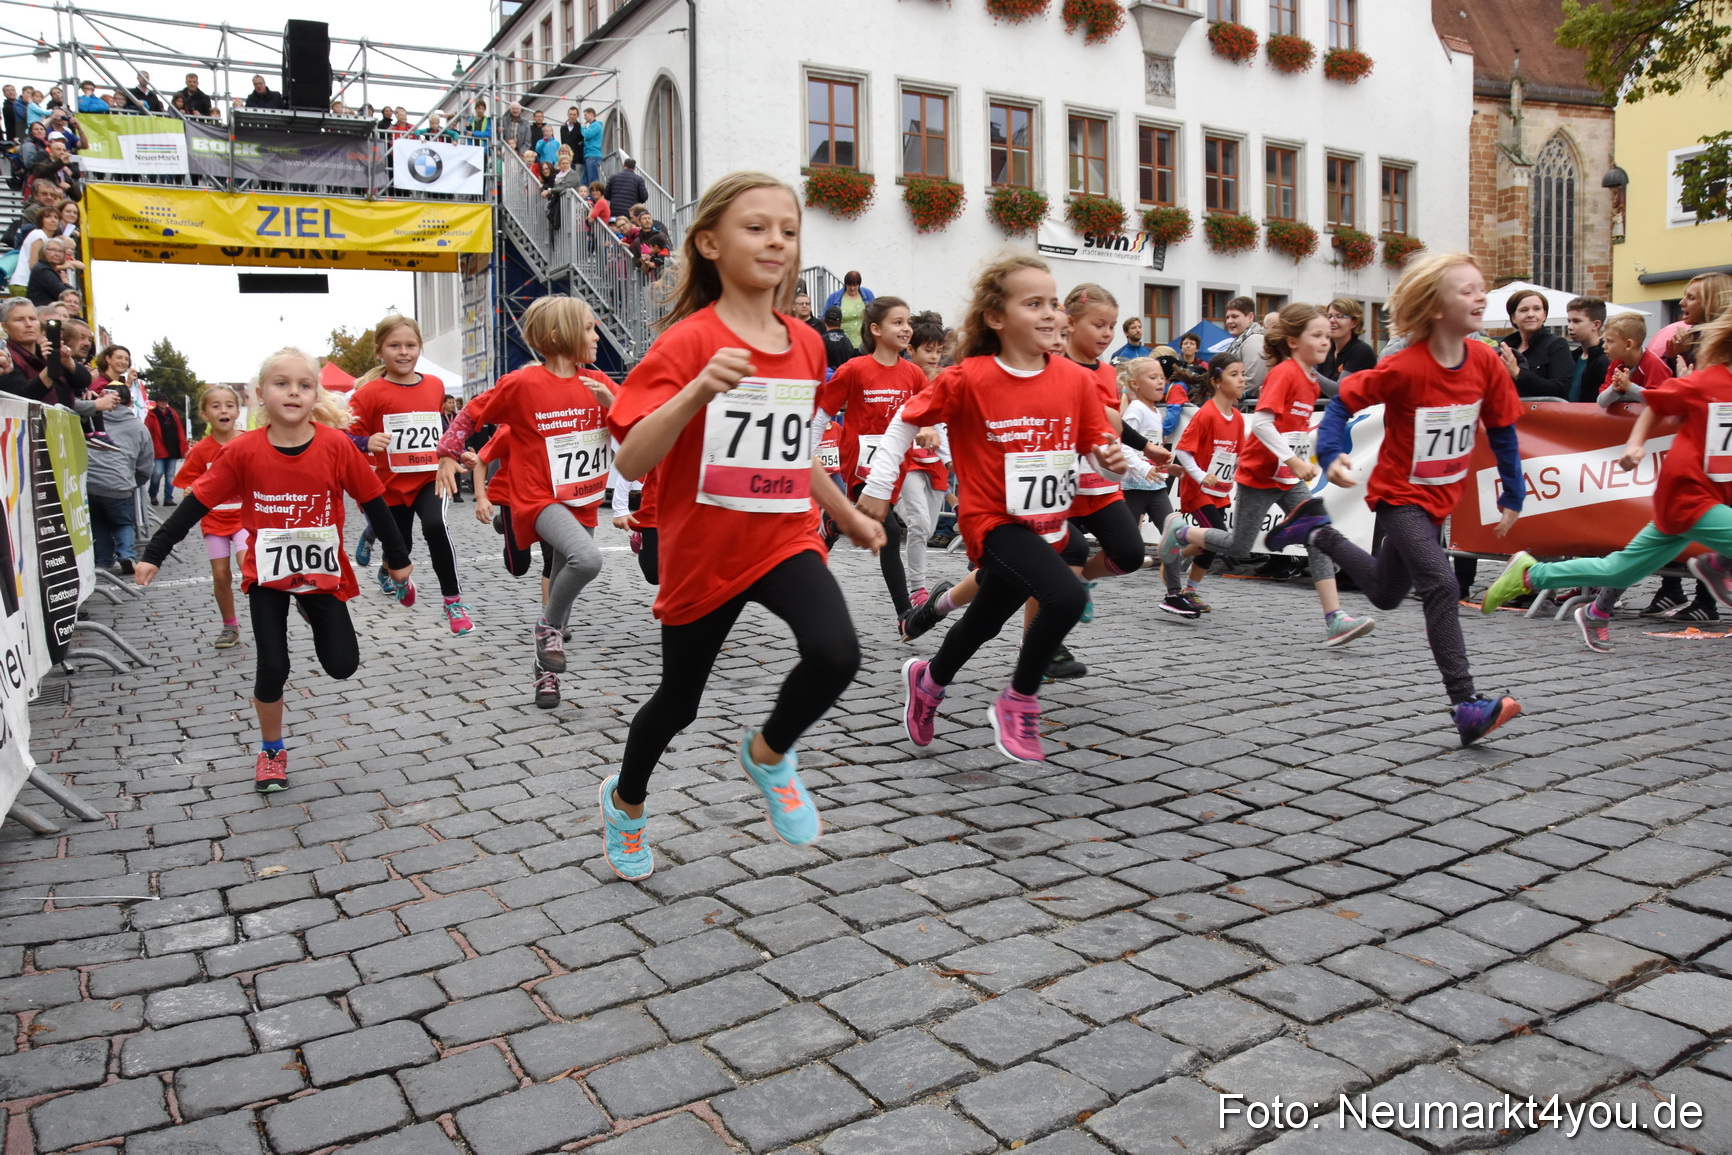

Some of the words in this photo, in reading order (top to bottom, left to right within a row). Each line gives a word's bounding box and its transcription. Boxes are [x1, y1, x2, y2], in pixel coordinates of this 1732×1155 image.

[192, 137, 261, 157] BOCK
[285, 160, 366, 172] www.bockonline.de
[112, 213, 163, 225] Neumarkter
[165, 217, 204, 228] Stadtlauf
[256, 205, 346, 239] ZIEL
[394, 229, 437, 237] Neumarkter
[439, 229, 473, 237] Stadtlauf
[1083, 231, 1129, 252] swn
[1081, 248, 1113, 258] stadtwerke
[1114, 252, 1141, 261] neumarkt
[864, 396, 894, 404] Stadtlauf
[535, 408, 586, 421] Neumarkter
[537, 418, 578, 432] Stadtlauf
[391, 426, 440, 450] 7229
[986, 430, 1034, 443] Stadtlauf
[408, 454, 433, 465] Ronja
[558, 444, 607, 480] 7241
[822, 454, 839, 467] 054
[750, 475, 795, 494] Carla
[253, 490, 308, 502] Neumarkter
[255, 502, 295, 516] Stadtlauf
[45, 555, 67, 569] Freizeit
[265, 544, 340, 577] 7060
[49, 587, 79, 604] Stadtbusse
